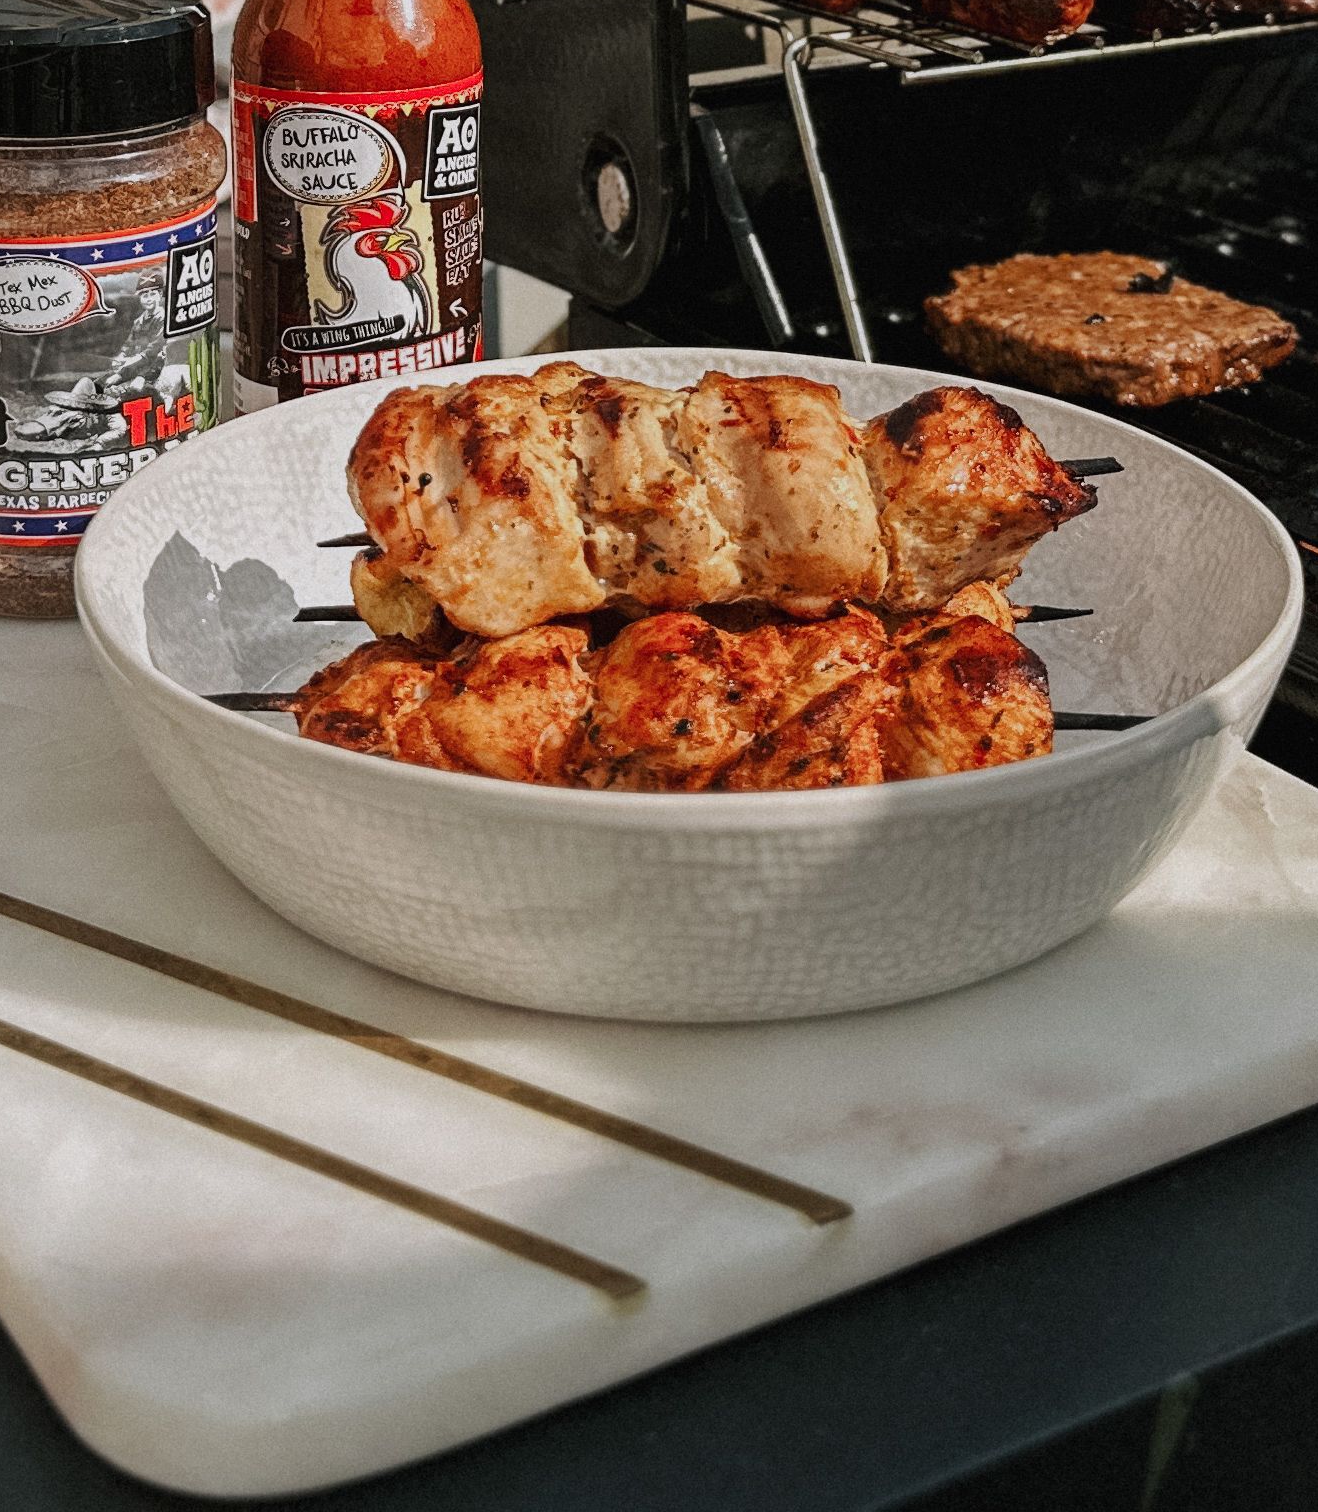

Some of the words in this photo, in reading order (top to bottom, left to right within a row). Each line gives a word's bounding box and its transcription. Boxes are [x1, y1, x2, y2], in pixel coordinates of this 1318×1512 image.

[282, 125, 359, 147] BUFFALO
[435, 116, 477, 155] AO
[281, 150, 357, 170] SRIRACHA
[434, 152, 477, 173] ANGUS
[301, 173, 359, 192] SAUCE
[433, 172, 447, 188] &
[448, 167, 477, 186] OINK
[177, 249, 214, 290] AO
[27, 274, 59, 290] Mex
[176, 283, 214, 308] ANGUS
[175, 308, 188, 323] &
[312, 332, 320, 347] A
[321, 327, 351, 346] WING
[351, 316, 396, 340] THING!!!
[301, 326, 467, 386] IMPRESSIVE
